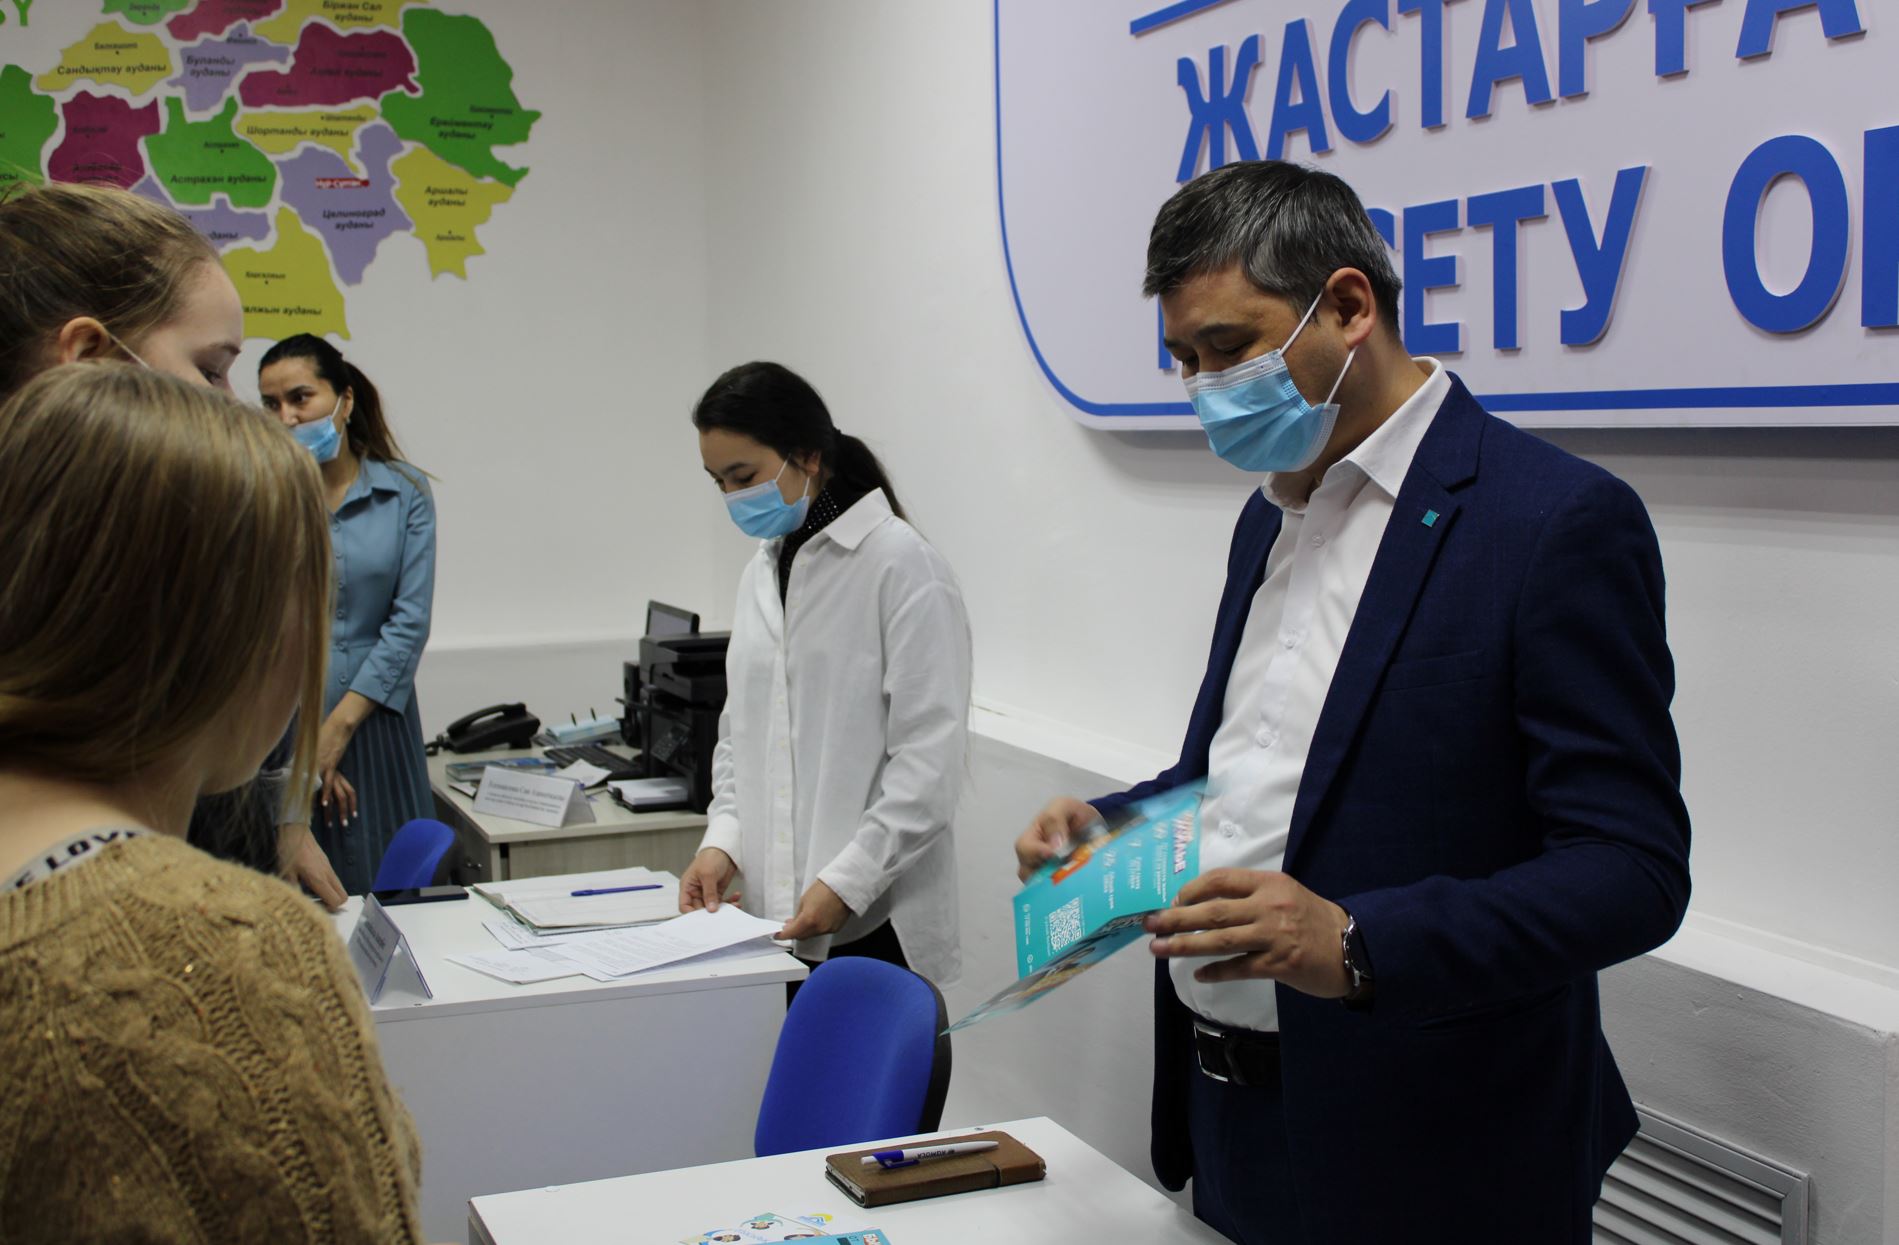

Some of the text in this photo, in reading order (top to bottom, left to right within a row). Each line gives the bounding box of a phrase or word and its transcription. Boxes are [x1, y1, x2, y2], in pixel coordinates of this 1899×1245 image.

[334, 13, 373, 23] ауданы
[186, 55, 235, 67] Буланды
[126, 63, 166, 75] ауданы
[190, 67, 231, 78] ауданы
[247, 126, 349, 138] Шортанды ауданы
[170, 174, 267, 185] Астрахан ауданы
[425, 186, 468, 196] Аршалы
[428, 197, 466, 207] ауданы
[322, 208, 385, 221] Целиноград
[335, 219, 374, 231] ауданы
[208, 231, 239, 241] даны
[1367, 165, 1650, 355] ЕТУ
[242, 305, 322, 316] алжын ауданы
[45, 831, 139, 870] LOV
